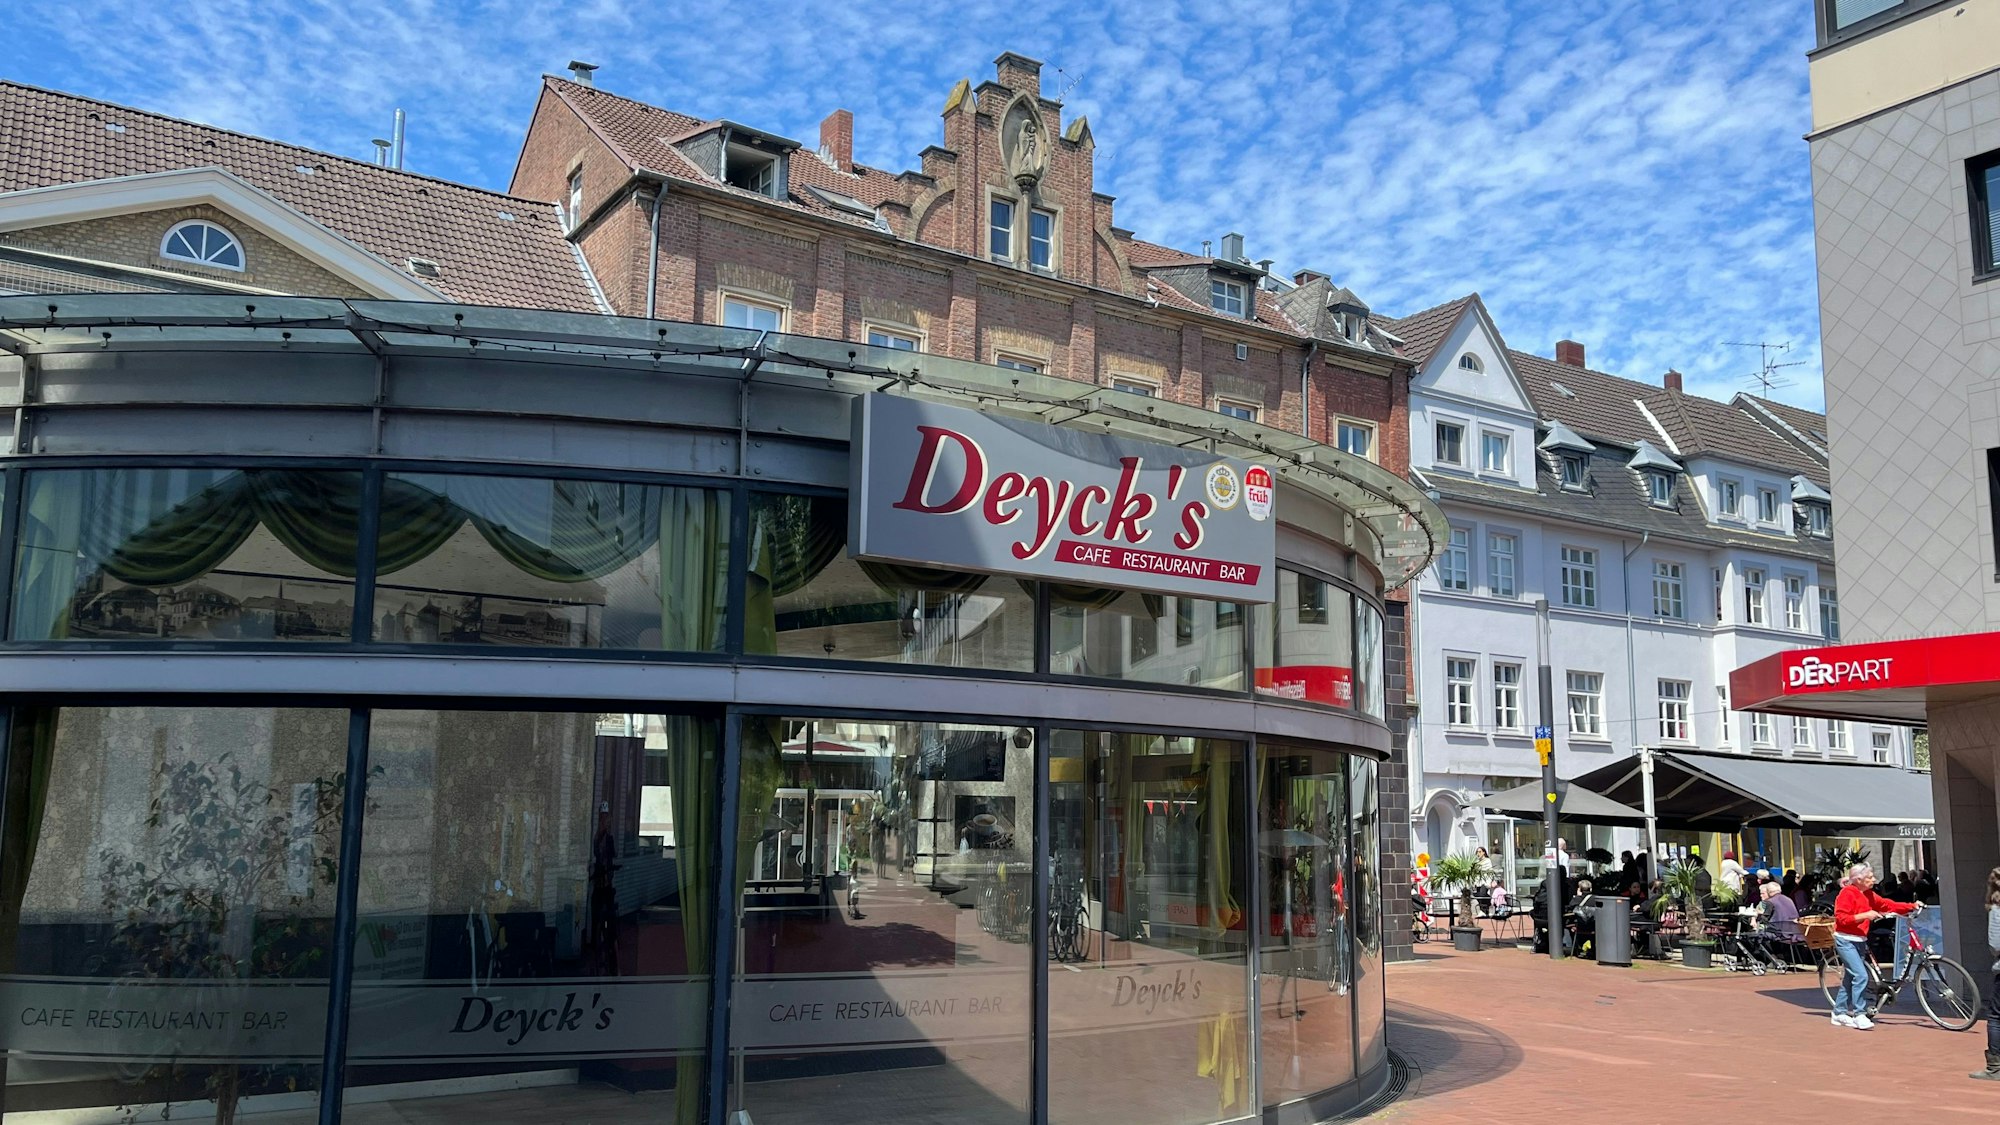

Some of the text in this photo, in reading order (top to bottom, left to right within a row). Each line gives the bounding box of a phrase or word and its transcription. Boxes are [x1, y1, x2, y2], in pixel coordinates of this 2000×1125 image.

[893, 425, 1210, 560] Deyck's
[1249, 488, 1268, 506] früh
[1073, 545, 1246, 581] CAFE RESTAURANT BAR
[1898, 825, 1911, 836] Eis
[1112, 970, 1202, 1016] Deyck's
[21, 1007, 289, 1030] CAFE RESTAURANT BAR
[449, 993, 614, 1046] Deyck's
[769, 997, 1002, 1023] CAFE RESTAURANT BAR
